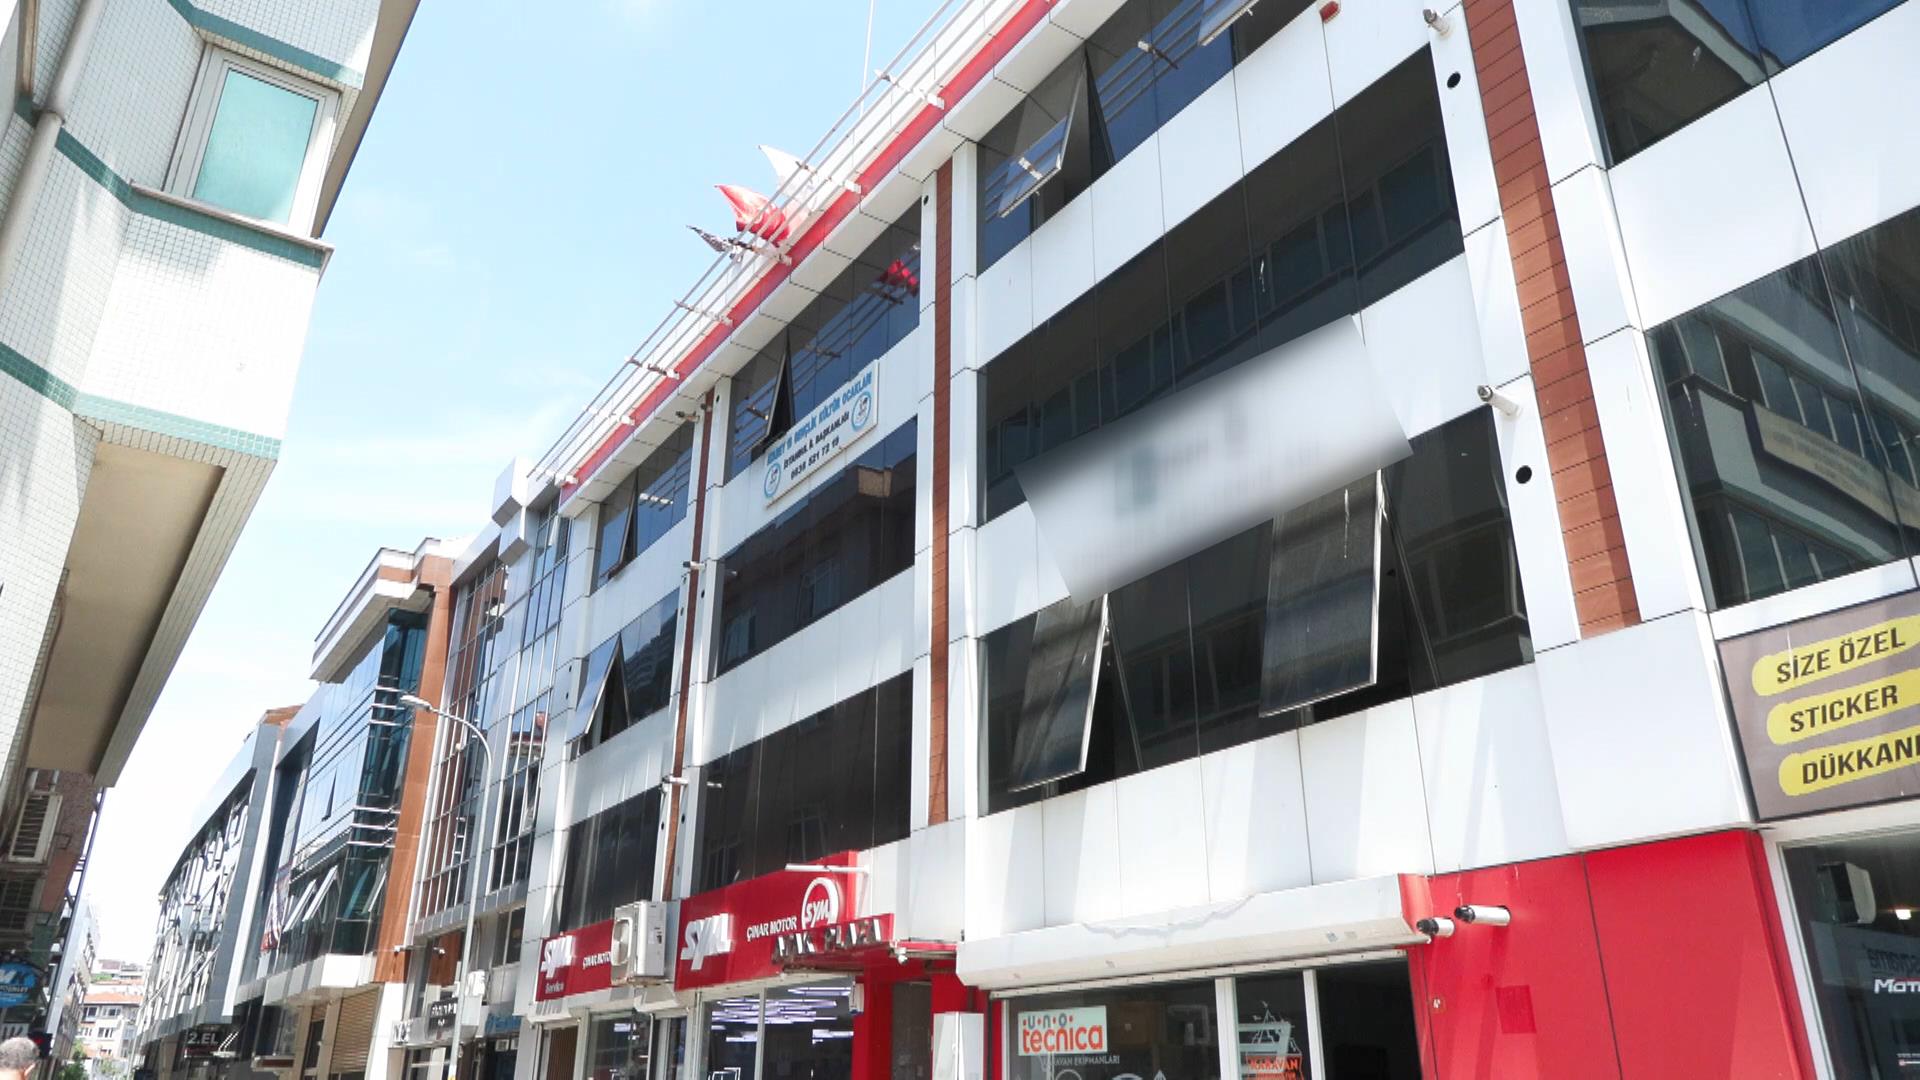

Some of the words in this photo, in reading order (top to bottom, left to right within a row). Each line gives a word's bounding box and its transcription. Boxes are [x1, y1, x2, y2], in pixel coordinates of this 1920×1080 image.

[1776, 647, 1831, 684] SİZE
[1838, 626, 1906, 666] ÖZEL
[1790, 683, 1898, 733] STICKER
[805, 899, 831, 927] SYM
[680, 913, 733, 971] SYM
[746, 922, 769, 942] ÇINAR
[770, 915, 798, 935] MOTOR
[1023, 1025, 1103, 1054] tecnica
